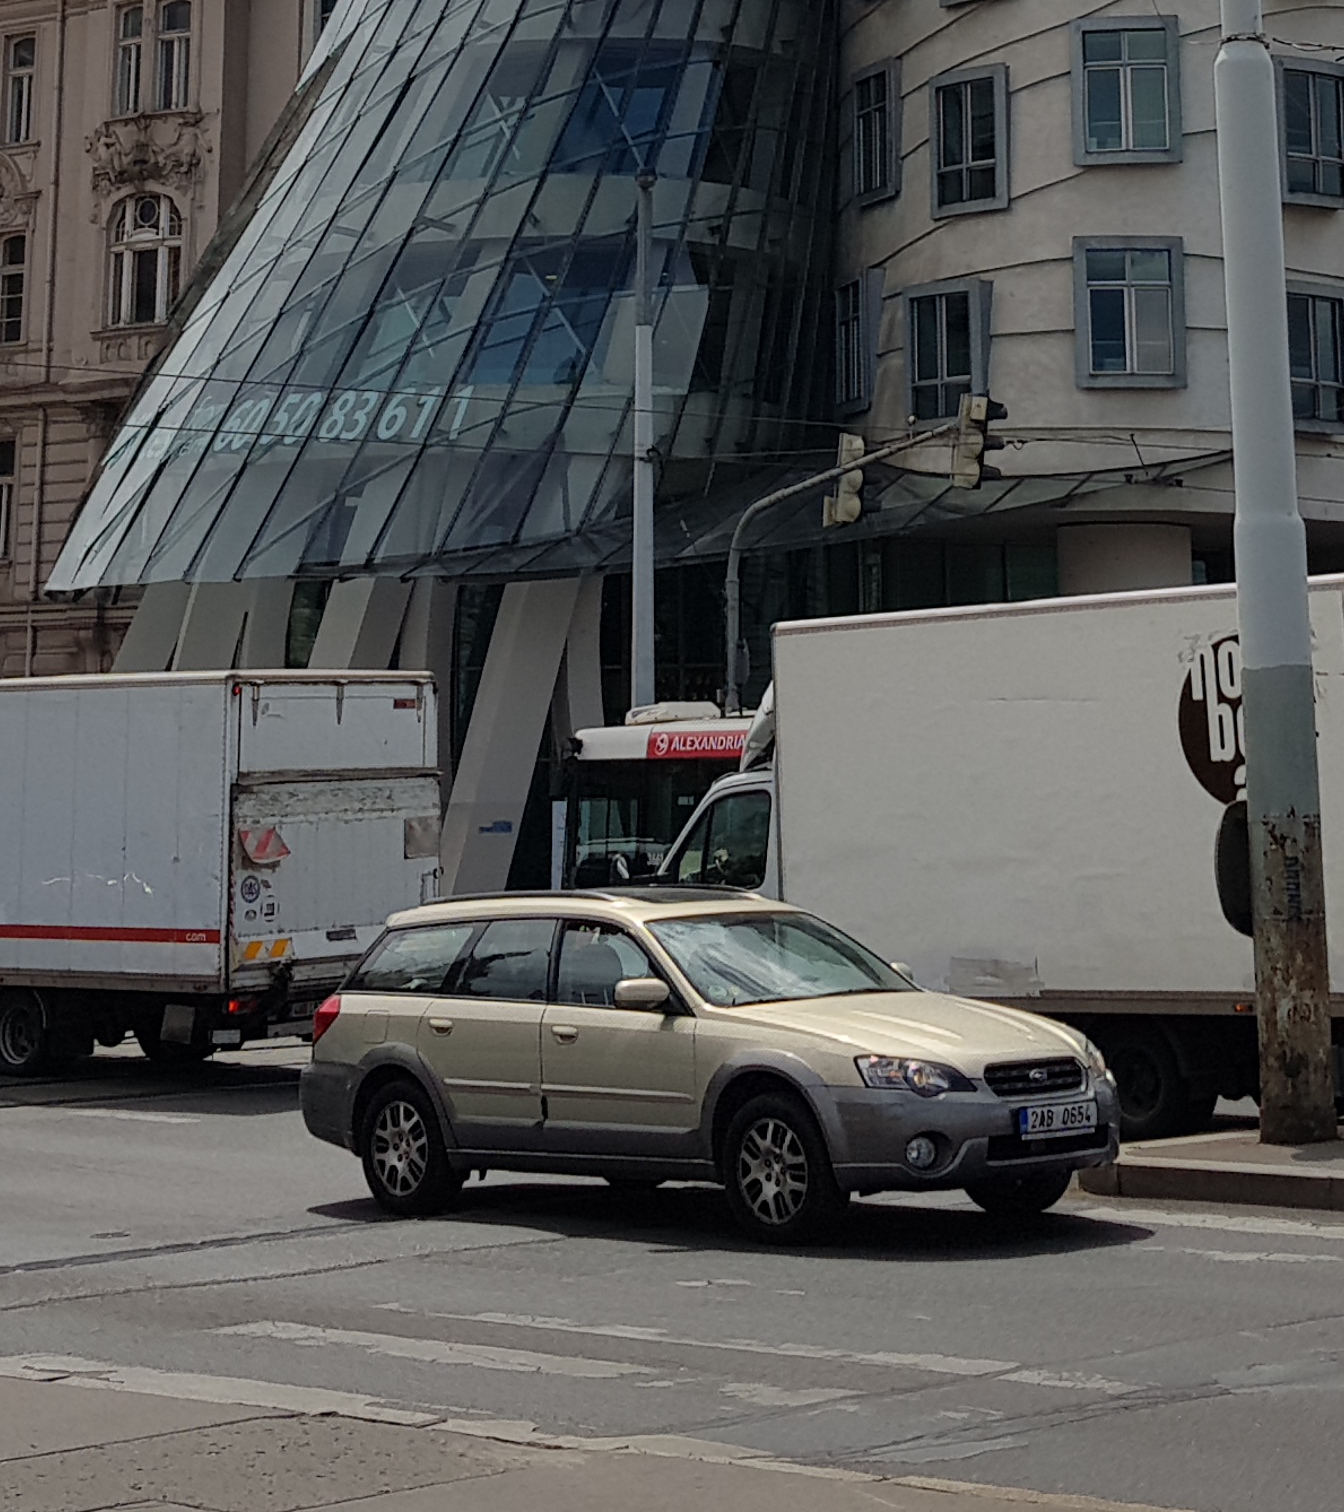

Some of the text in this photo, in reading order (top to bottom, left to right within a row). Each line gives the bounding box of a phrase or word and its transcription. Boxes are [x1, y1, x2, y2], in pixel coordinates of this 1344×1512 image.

[670, 733, 746, 752] ALEXANDRIA
[1030, 1103, 1092, 1129] 2AB 0654
